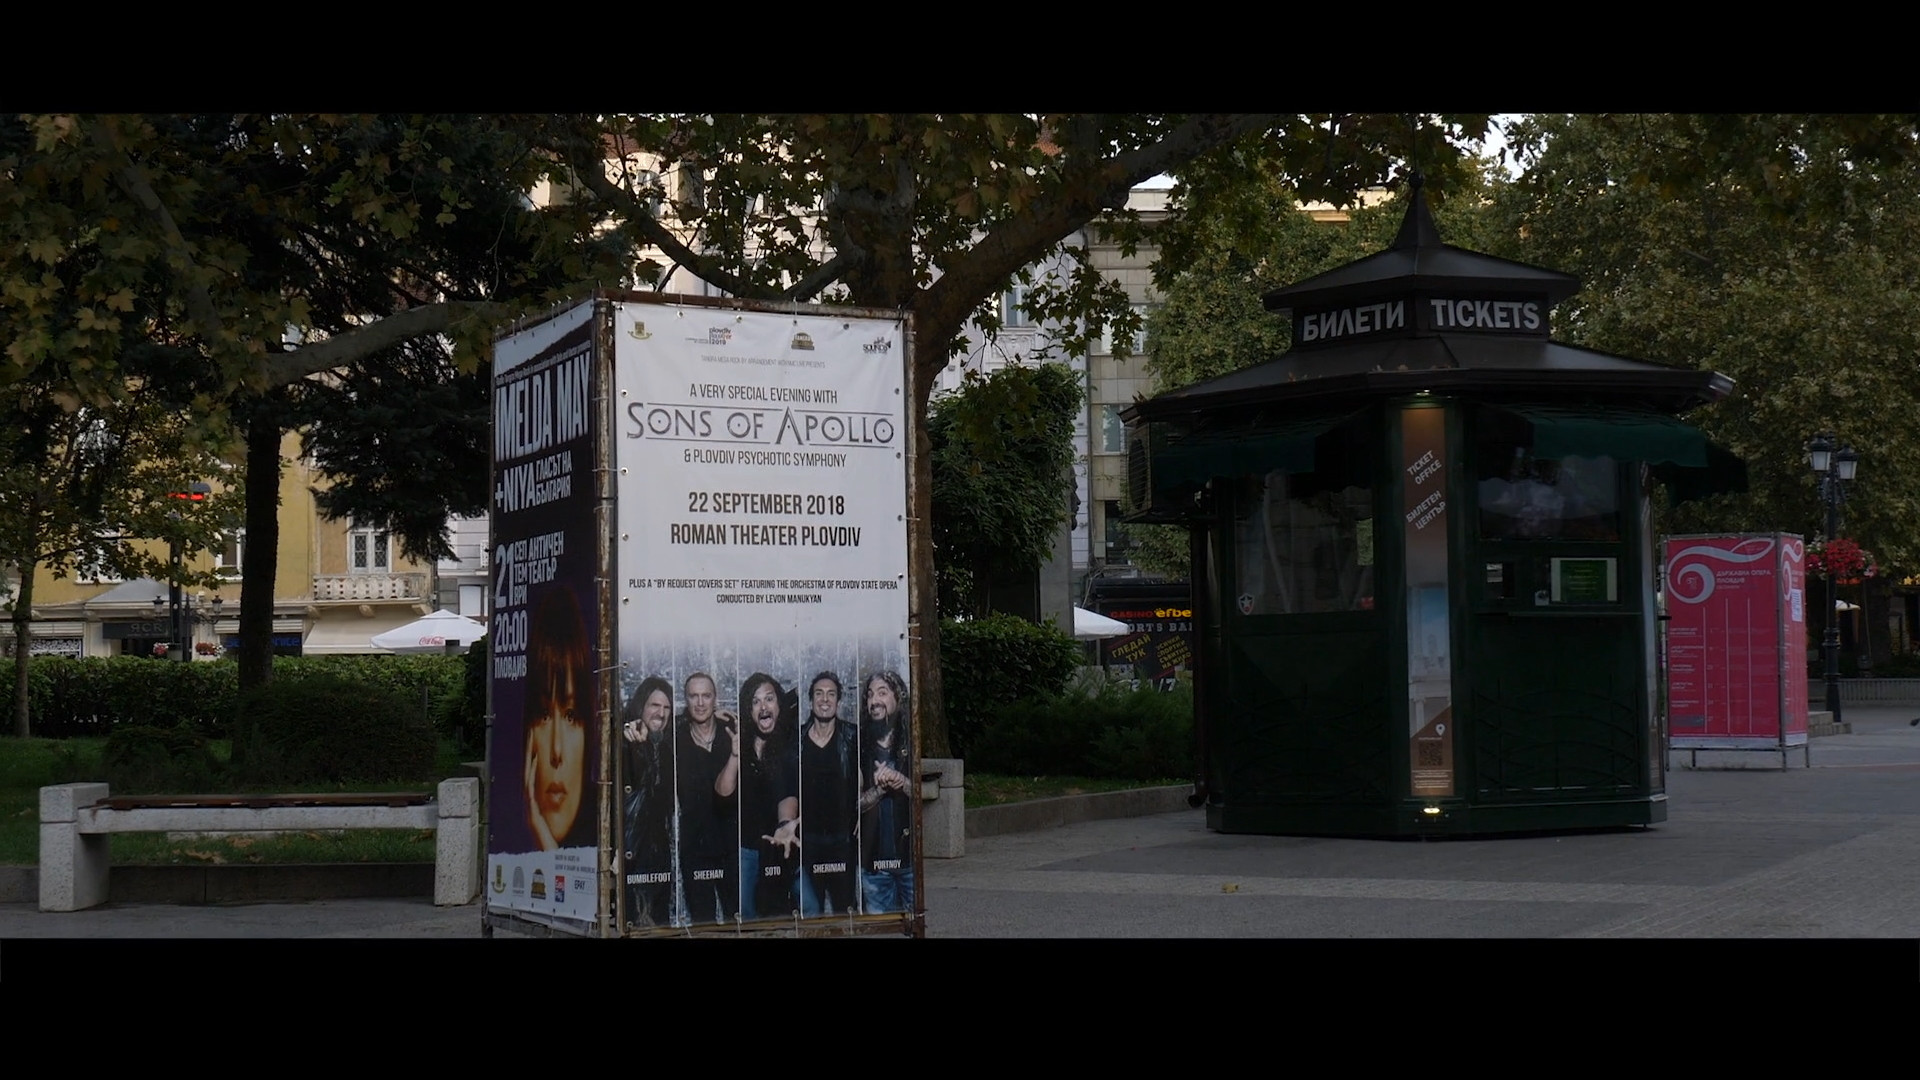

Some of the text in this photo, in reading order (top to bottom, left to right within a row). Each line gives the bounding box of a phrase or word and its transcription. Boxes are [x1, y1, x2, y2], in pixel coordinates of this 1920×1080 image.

[1303, 299, 1404, 342] БИЛЕТИ
[1430, 299, 1540, 330] TICKETS
[689, 383, 838, 404] A VERY SPECIAL EVENING WITH
[494, 351, 591, 463] IMELDA MAY
[626, 402, 895, 446] SONS OF APOLLO
[684, 449, 847, 468] & PLOVDIV PSYCHOTIC SYMPHONY
[1407, 450, 1434, 475] TICKET
[1414, 459, 1442, 485] OFFICE
[536, 475, 571, 506] БЪЛГАРИЯ
[688, 492, 845, 515] 22 SEPTEMBER 2018
[1406, 490, 1442, 523] БИЛЕТЕН
[1414, 501, 1446, 530] ЦЕНТЪР
[528, 531, 565, 561] АНТИЧЕН
[671, 523, 861, 547] ROMAN THEATER PLOVDIV
[513, 538, 528, 562] СЕП
[495, 544, 514, 609] 21
[513, 562, 528, 584] ТЕМ
[528, 557, 558, 585] ТЕАТЪР
[513, 584, 528, 606] ВРИ
[629, 579, 646, 588] PLUS
[647, 579, 652, 588] A
[667, 579, 697, 588] REQUEST
[697, 579, 723, 588] COVERS
[741, 579, 776, 589] FEATURING
[777, 579, 788, 589] THE
[790, 579, 826, 589] ORCHESTRA
[827, 580, 834, 589] OF
[836, 580, 860, 589] PLOVDIV
[861, 580, 878, 590] STATE
[879, 580, 898, 590] OPERA
[716, 594, 822, 603] CONDUCTED BY LEVON MANUKYAN
[494, 609, 528, 654] 20:00
[1125, 648, 1147, 662] ТУК
[494, 654, 528, 681] ПЛОВДИВ
[693, 869, 724, 881] SHEEHAN
[764, 865, 781, 876] SOTO
[812, 862, 847, 874] SHERINIAN
[873, 859, 902, 871] PORTNOY
[626, 871, 671, 885] BUMBLEFOOT
